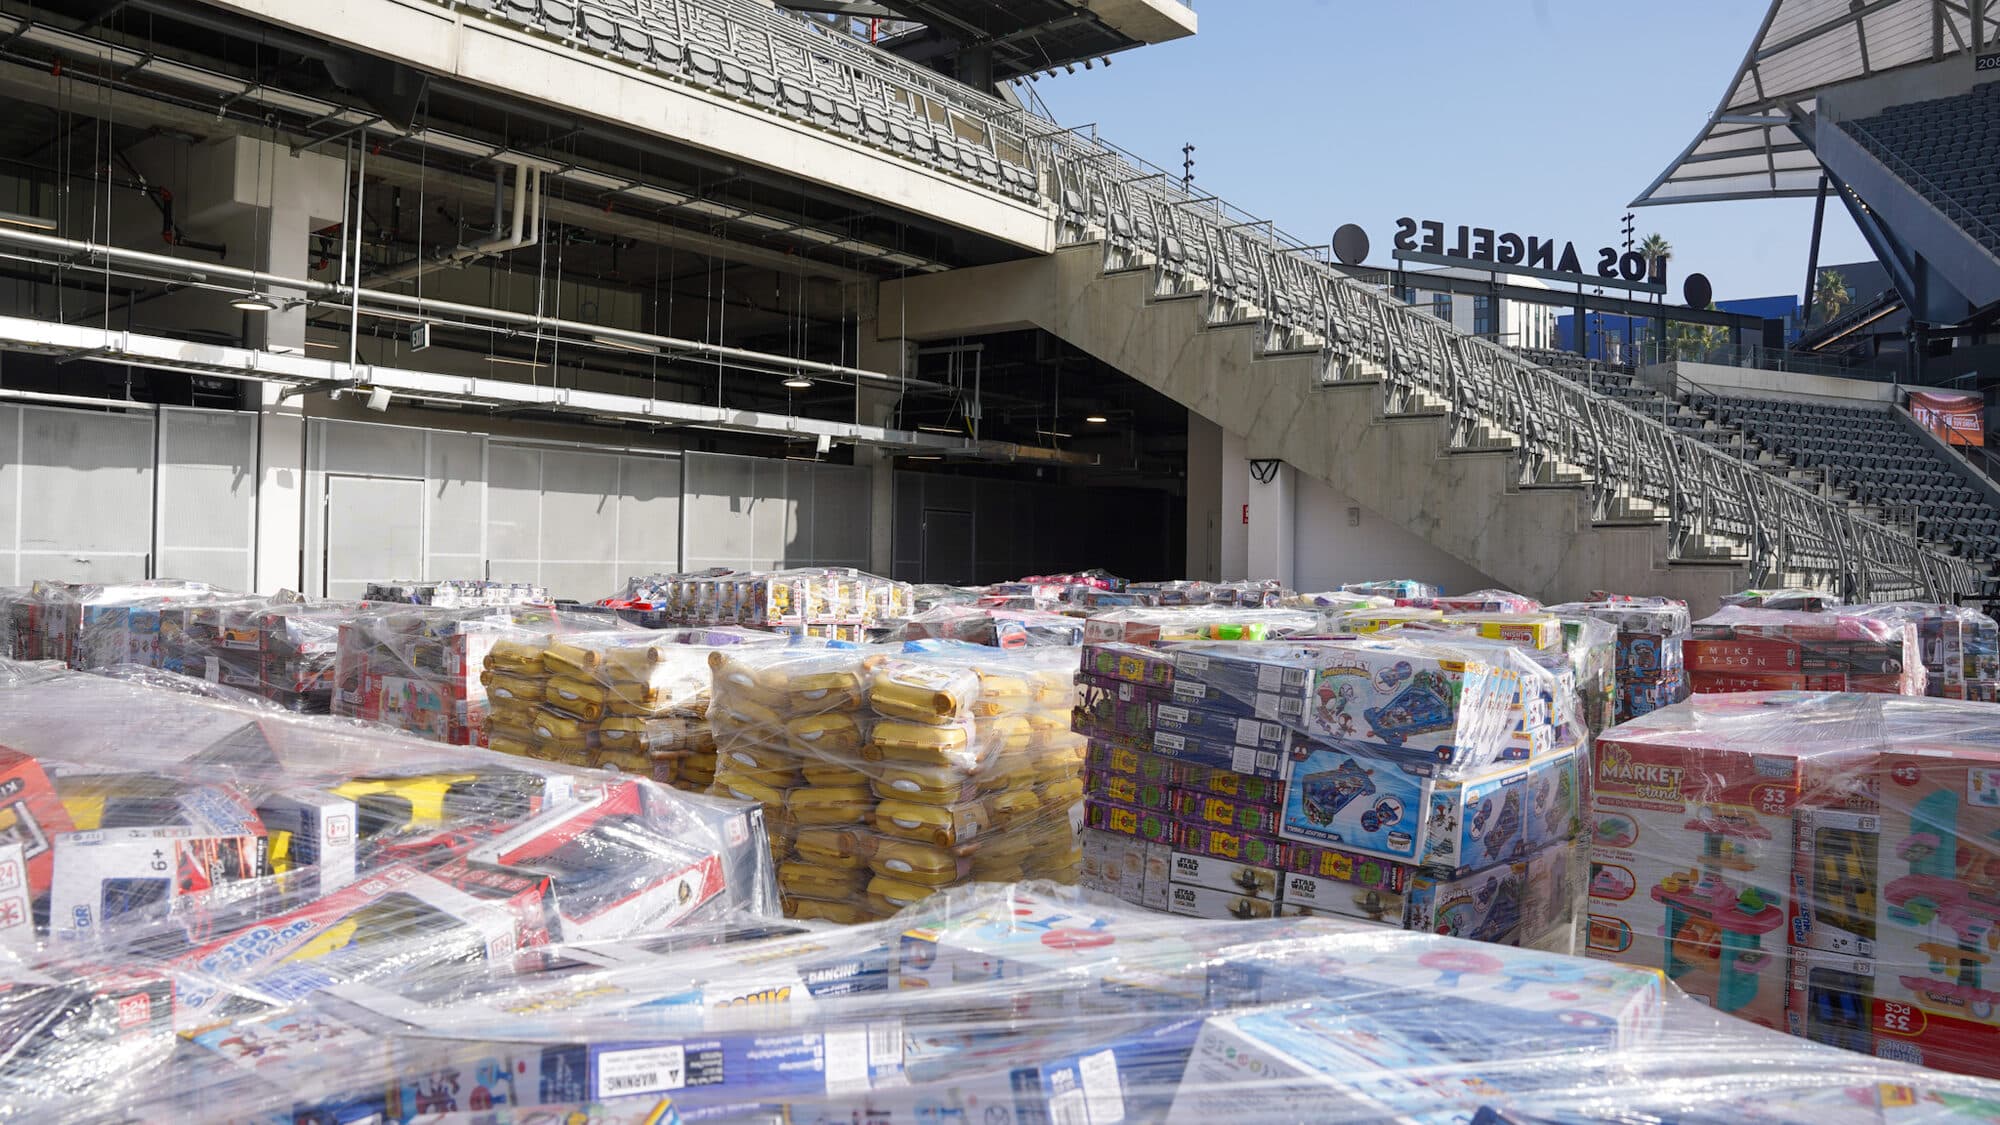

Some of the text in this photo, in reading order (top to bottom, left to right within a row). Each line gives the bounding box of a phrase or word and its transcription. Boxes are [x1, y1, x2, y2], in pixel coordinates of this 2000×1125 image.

[412, 327, 425, 348] EXIT
[1709, 647, 1754, 655] MIKE
[1325, 658, 1371, 671] SPIDEY
[1697, 655, 1767, 666] TYSON
[1715, 678, 1759, 687] MIKE
[1601, 763, 1683, 785] MARKET
[1896, 767, 1916, 780] 3+
[1763, 788, 1786, 804] 33
[1762, 803, 1785, 815] PCS
[1176, 862, 1199, 870] WARS
[1291, 883, 1316, 893] WARS
[1293, 878, 1315, 886] STAR
[1174, 893, 1196, 902] WARS
[1794, 918, 1804, 943] FORD
[808, 963, 863, 983] DANCING
[1884, 1002, 1911, 1016] PCS
[1884, 1015, 1910, 1032] 33
